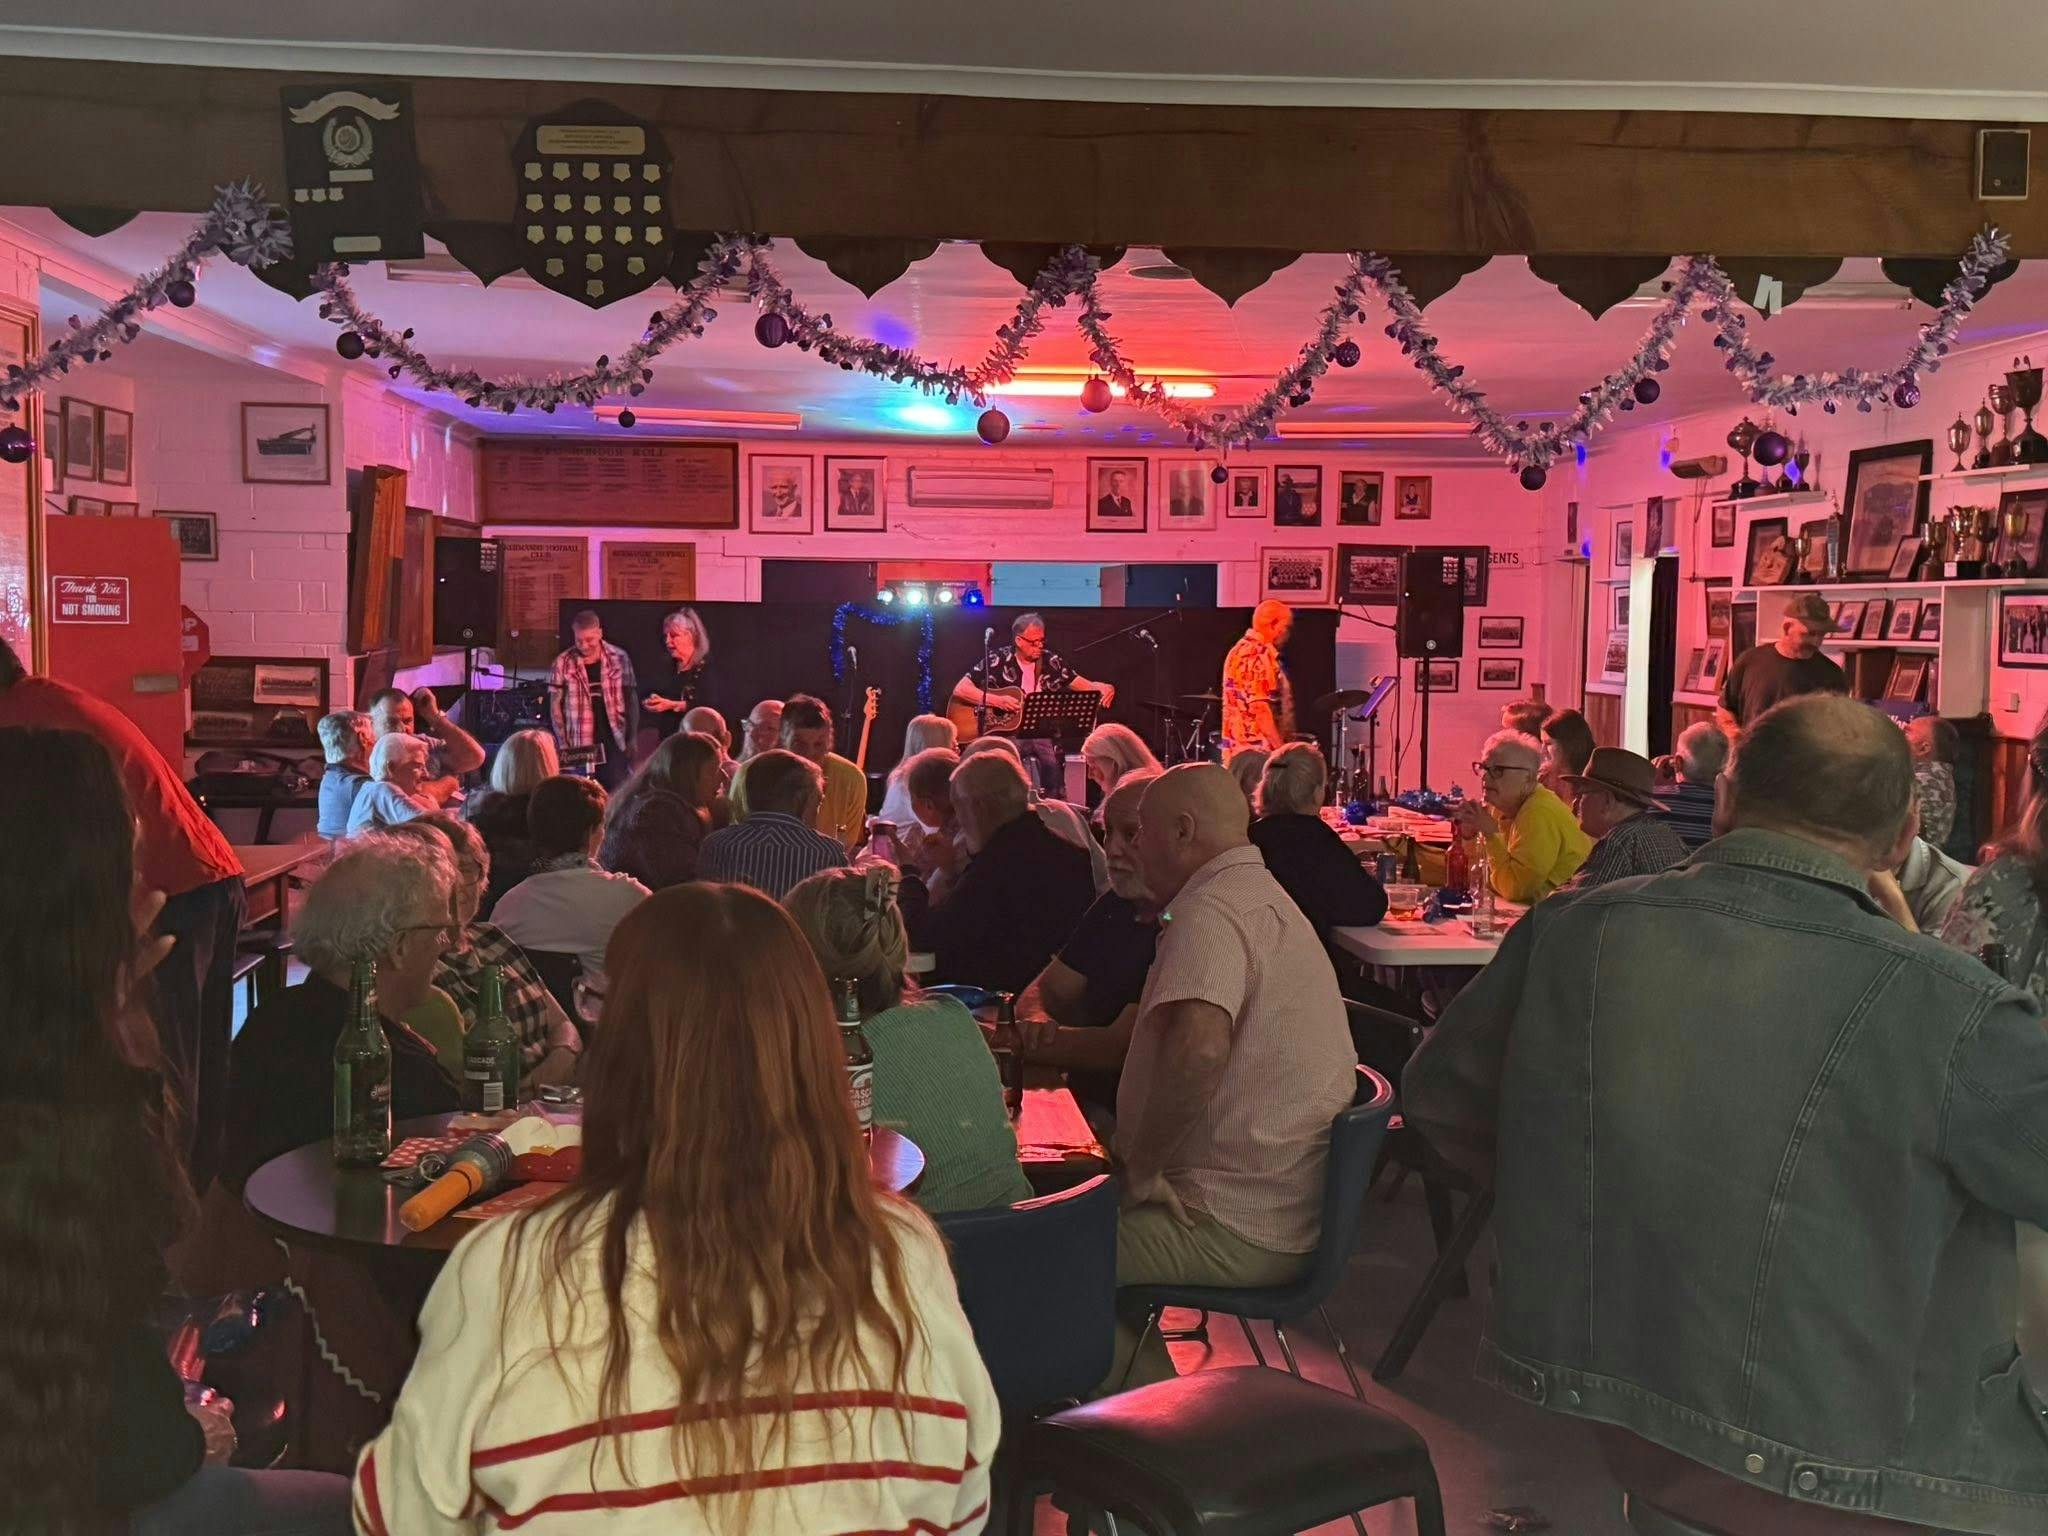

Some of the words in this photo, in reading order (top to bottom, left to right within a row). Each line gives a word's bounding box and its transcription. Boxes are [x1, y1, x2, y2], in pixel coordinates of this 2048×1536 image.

[60, 581, 97, 593] Thank
[101, 582, 120, 594] You
[85, 595, 97, 603] FOR
[62, 604, 79, 615] NOT
[82, 604, 121, 616] SMOKING
